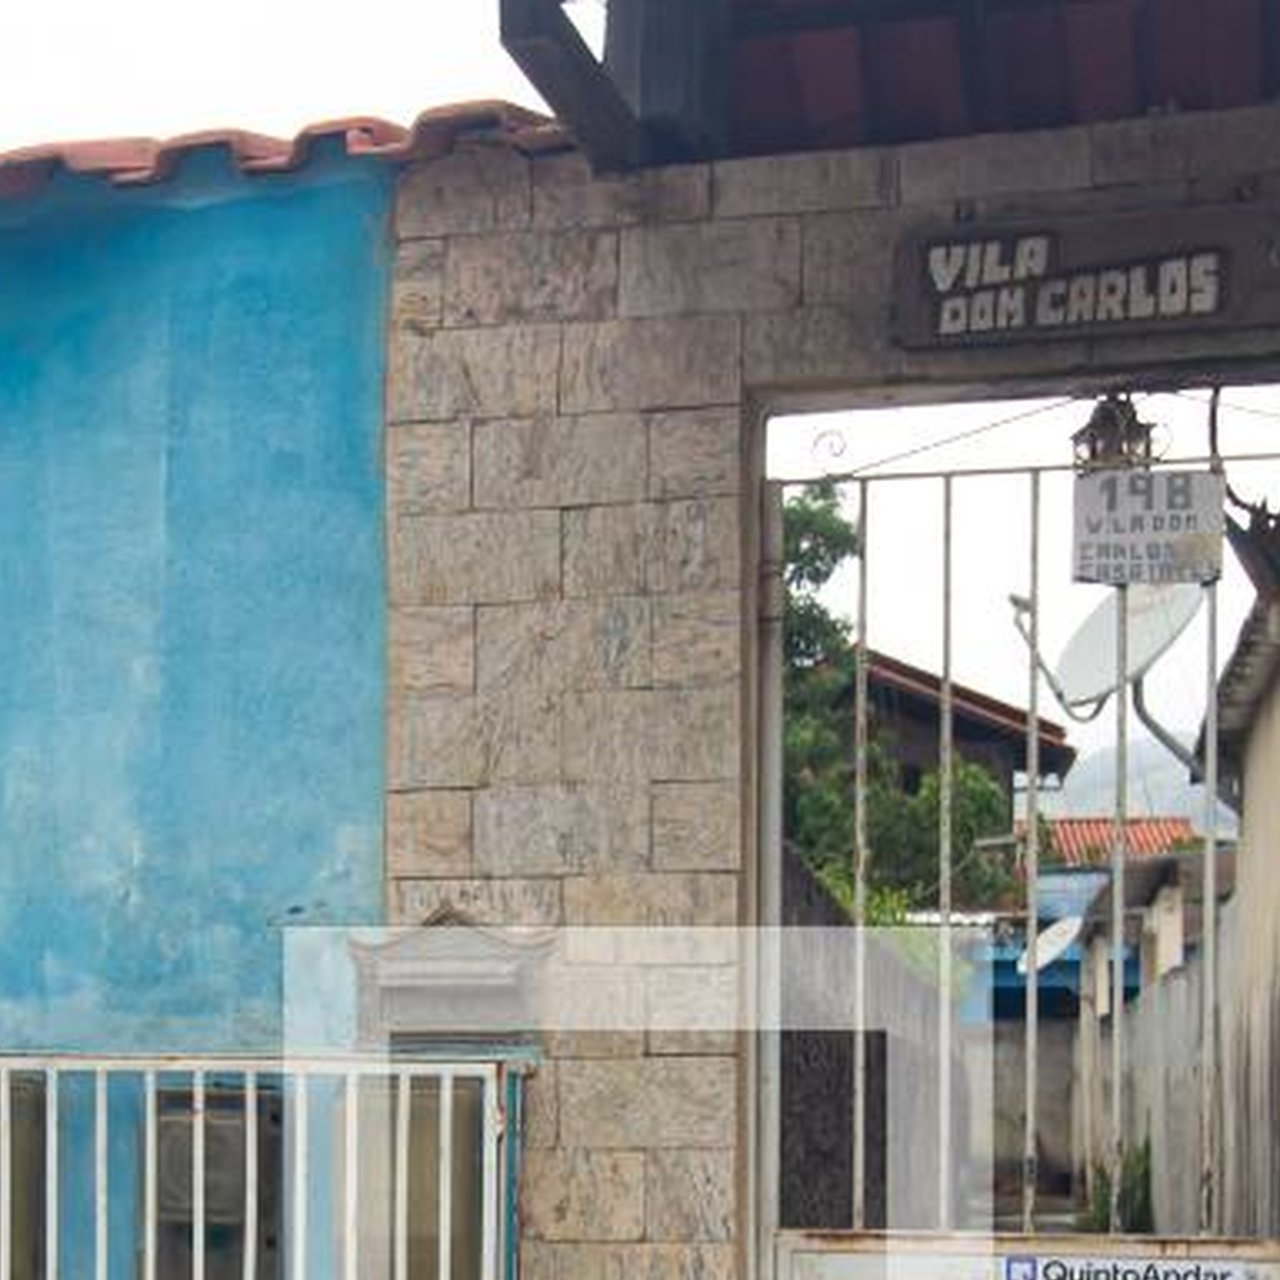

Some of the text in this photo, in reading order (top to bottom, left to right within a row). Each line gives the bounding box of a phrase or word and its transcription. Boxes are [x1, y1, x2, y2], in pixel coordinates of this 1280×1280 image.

[928, 236, 1050, 291] VILA
[939, 252, 1219, 335] DOM CARLOS
[1099, 473, 1192, 512] 198
